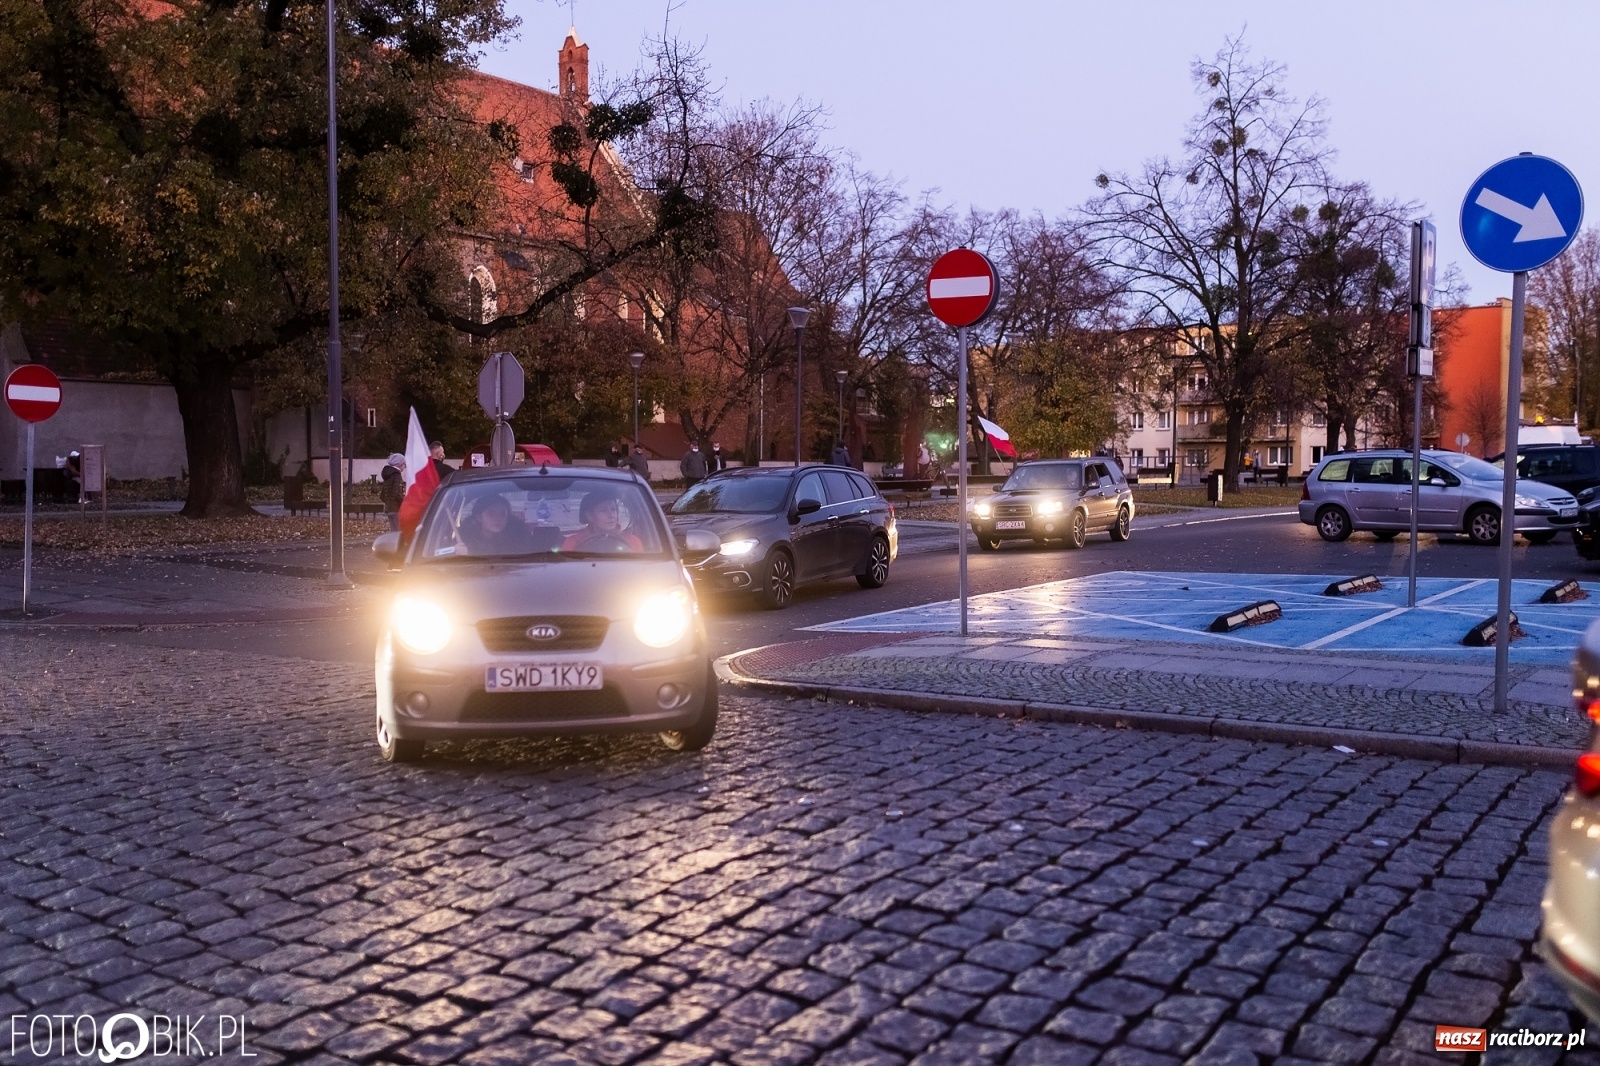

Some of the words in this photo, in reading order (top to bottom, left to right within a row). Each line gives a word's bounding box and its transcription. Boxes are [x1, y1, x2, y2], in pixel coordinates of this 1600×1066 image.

[532, 628, 555, 637] KIA
[500, 668, 542, 687] SWD
[551, 666, 597, 686] 1KY9
